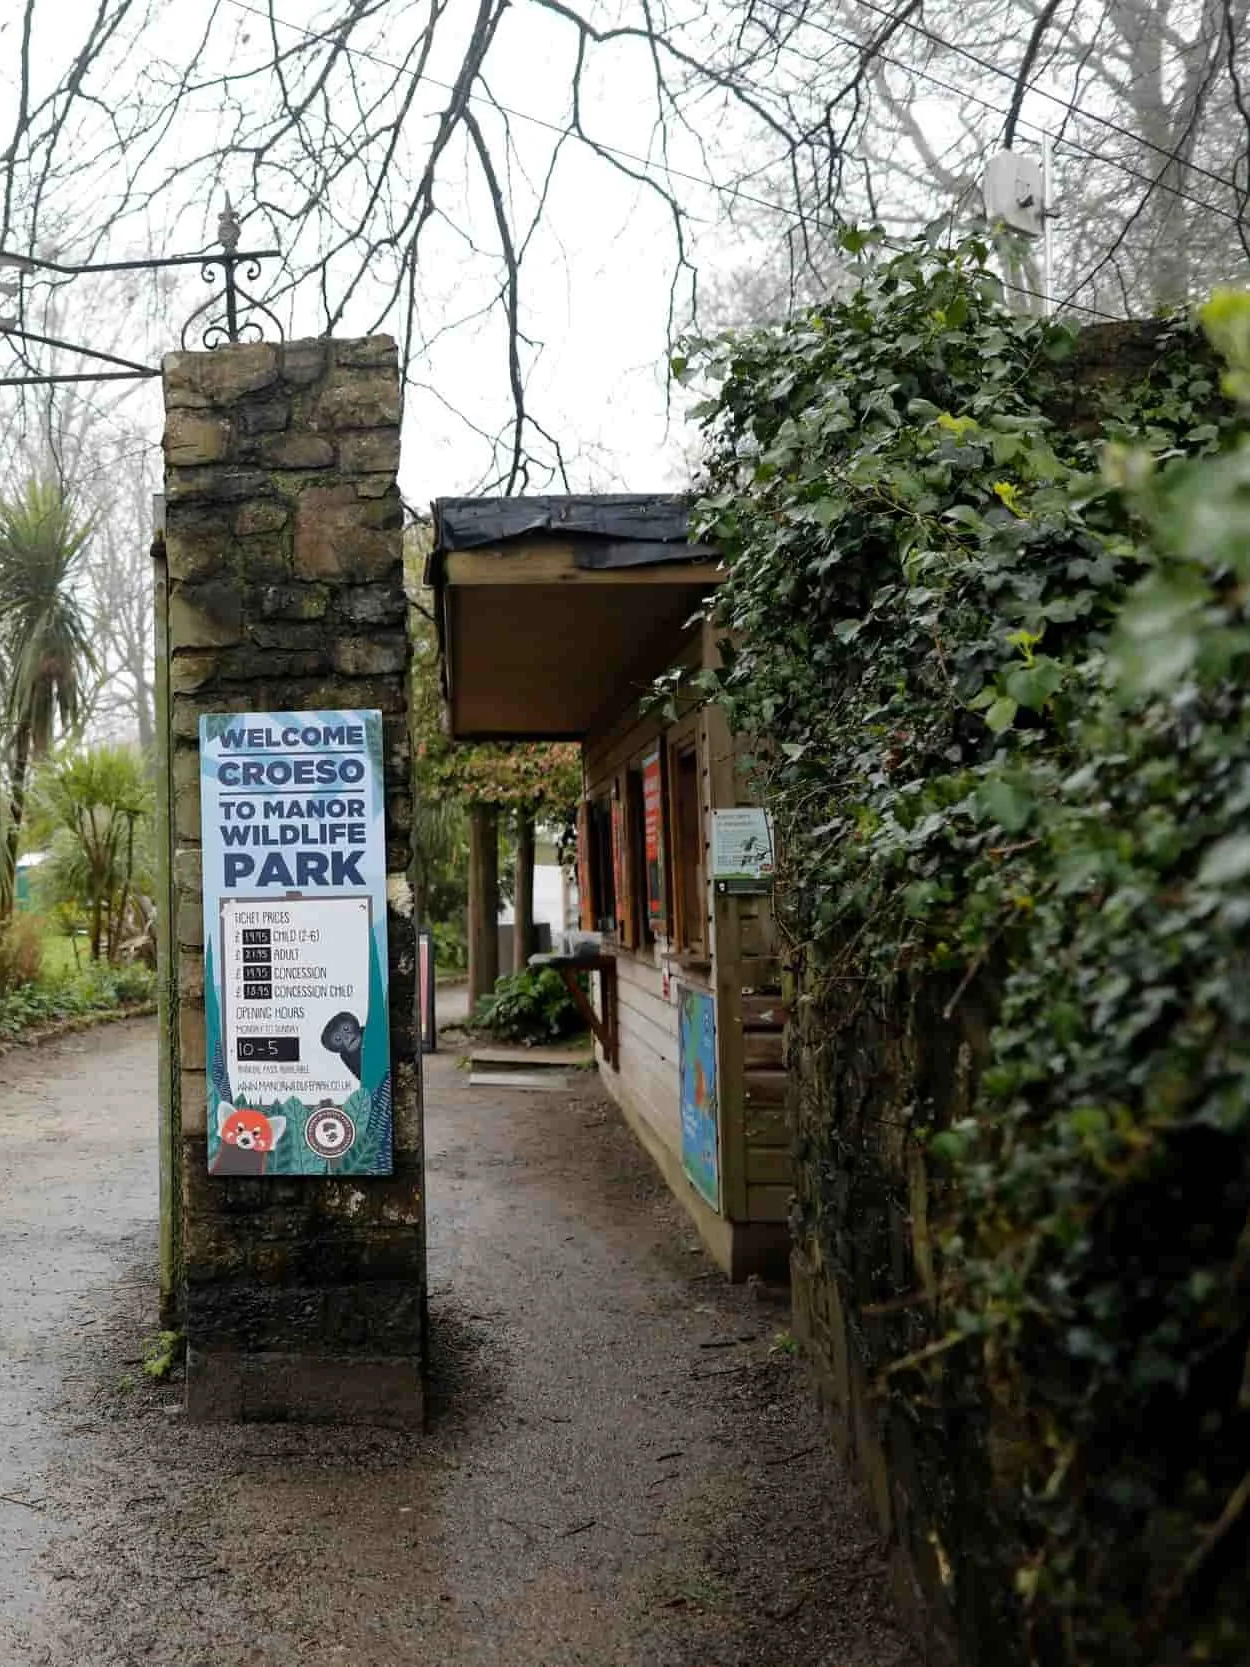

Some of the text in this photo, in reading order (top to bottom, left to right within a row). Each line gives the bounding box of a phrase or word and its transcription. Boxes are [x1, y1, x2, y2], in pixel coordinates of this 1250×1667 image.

[220, 726, 363, 748] WELCOME
[217, 759, 365, 786] CROESO
[219, 799, 365, 820] TO MANOR
[220, 823, 366, 846] WILDLIFE
[224, 851, 366, 887] PARK
[235, 911, 291, 924] TICKET PRICES
[273, 930, 296, 942] CHILD
[273, 948, 300, 961] ADULT
[274, 966, 327, 979] CONCESSION
[275, 985, 327, 998] CONCESSION
[330, 984, 354, 998] CHILD
[236, 1006, 304, 1020] OPENING HOURS
[239, 1041, 254, 1056] 10
[268, 1040, 279, 1056] 5
